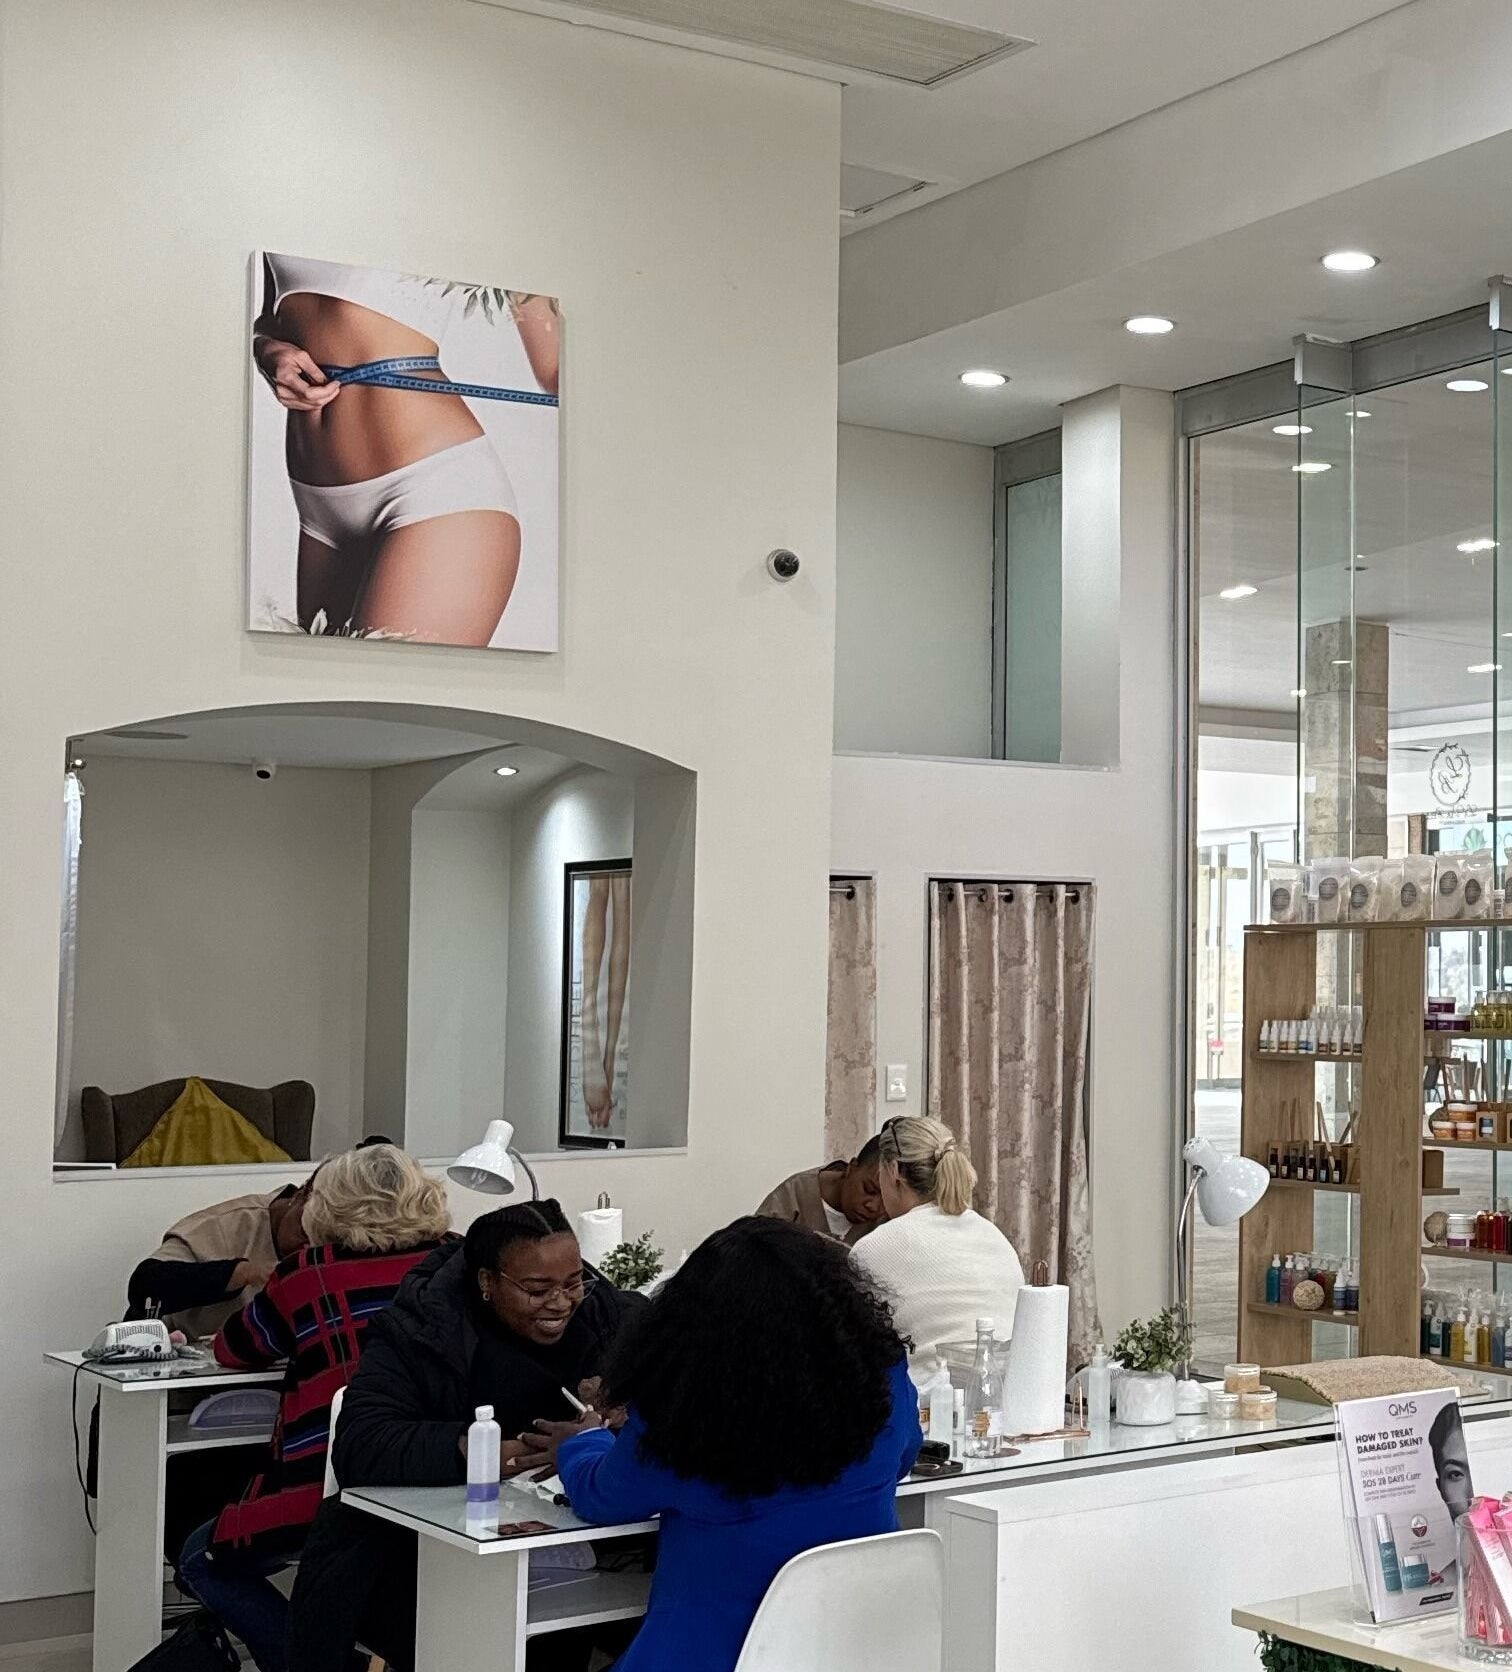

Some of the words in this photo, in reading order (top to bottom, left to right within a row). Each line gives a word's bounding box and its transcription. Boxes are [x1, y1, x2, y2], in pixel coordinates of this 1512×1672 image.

[1388, 1401, 1418, 1417] QMS
[1355, 1432, 1377, 1444] HOW
[1377, 1431, 1389, 1440] TO
[1390, 1427, 1414, 1440] TREAT
[1356, 1441, 1398, 1455] DAMAGED
[1399, 1436, 1424, 1448] SKIN?
